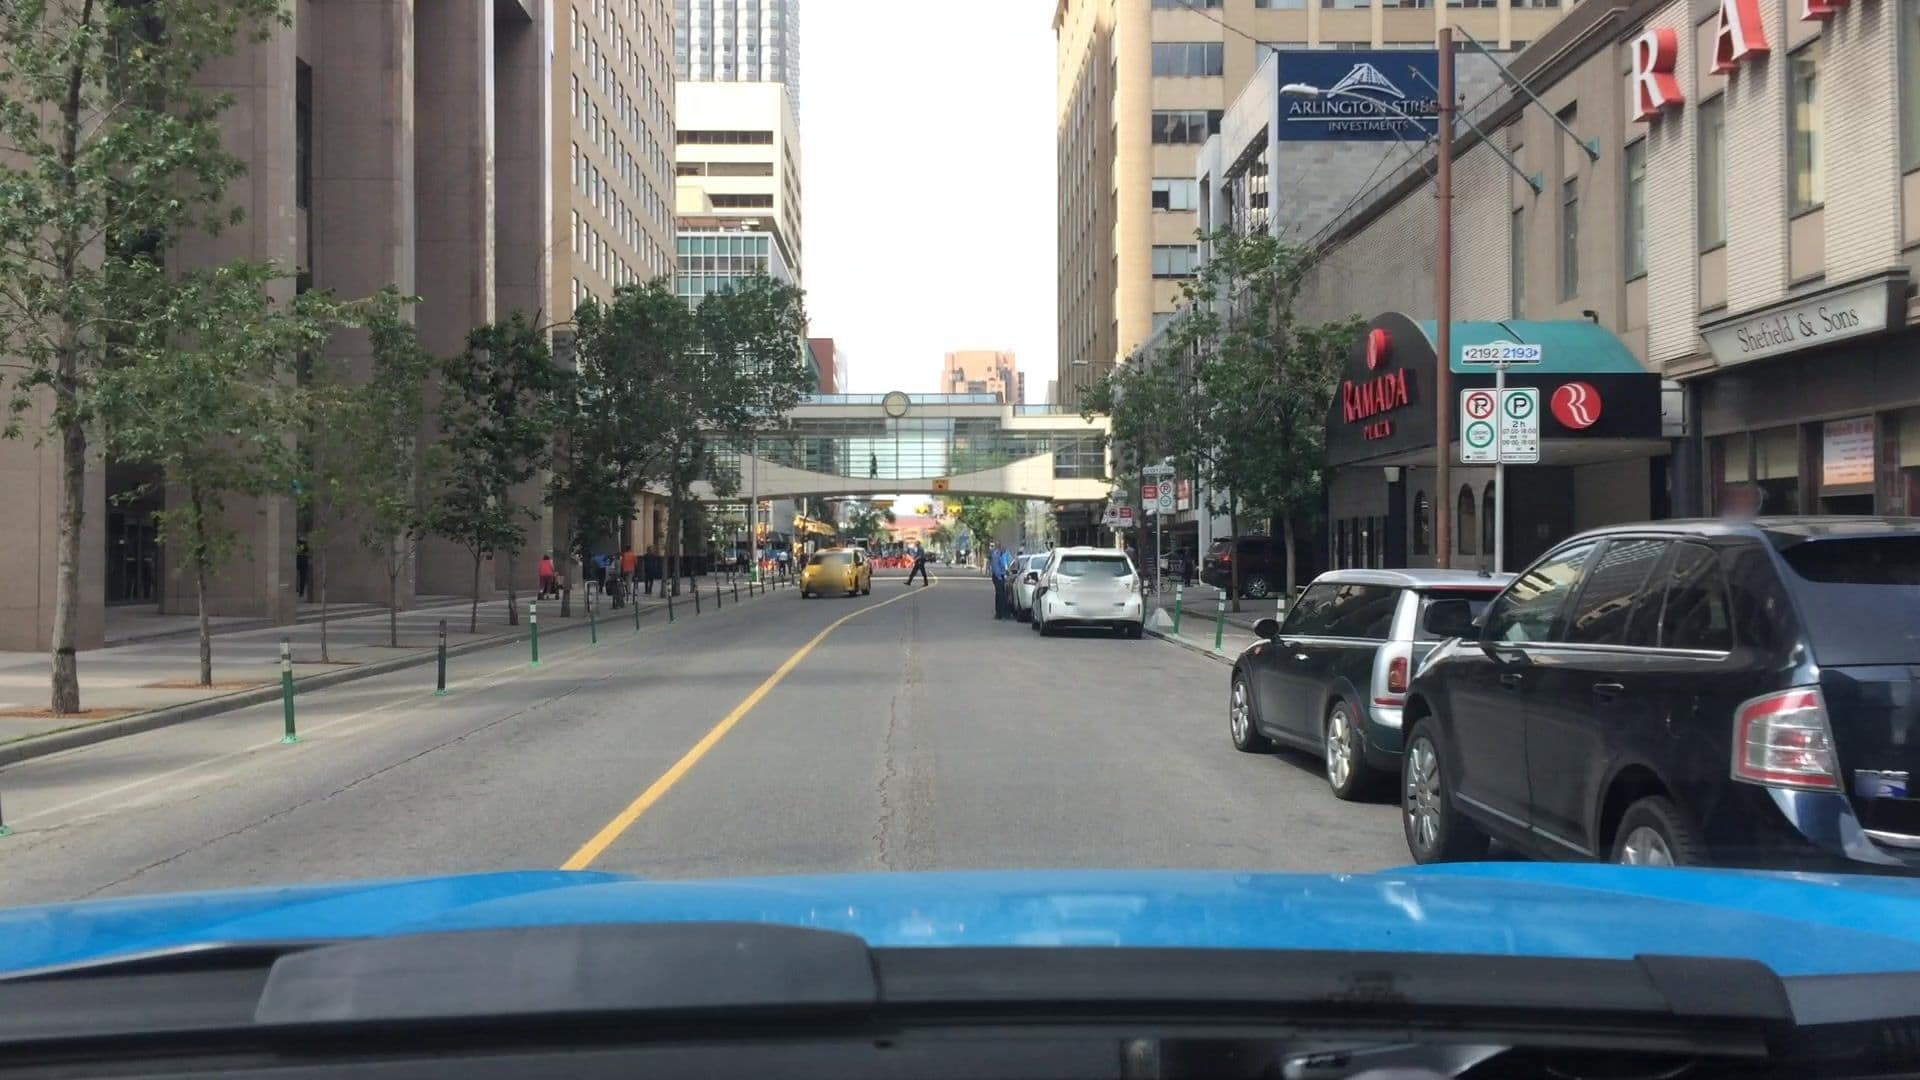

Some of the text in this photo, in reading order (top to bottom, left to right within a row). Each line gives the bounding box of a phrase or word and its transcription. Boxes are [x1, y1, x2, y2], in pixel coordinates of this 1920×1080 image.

[1289, 99, 1440, 114] ARLINGTON STREE
[1328, 120, 1409, 131] INVESTMENTS
[1736, 306, 1860, 353] Shefield & Sons
[1470, 347, 1533, 359] 2192 2193
[1343, 367, 1408, 424] RAMADA
[1513, 397, 1527, 414] P
[1363, 419, 1391, 441] PLAZA
